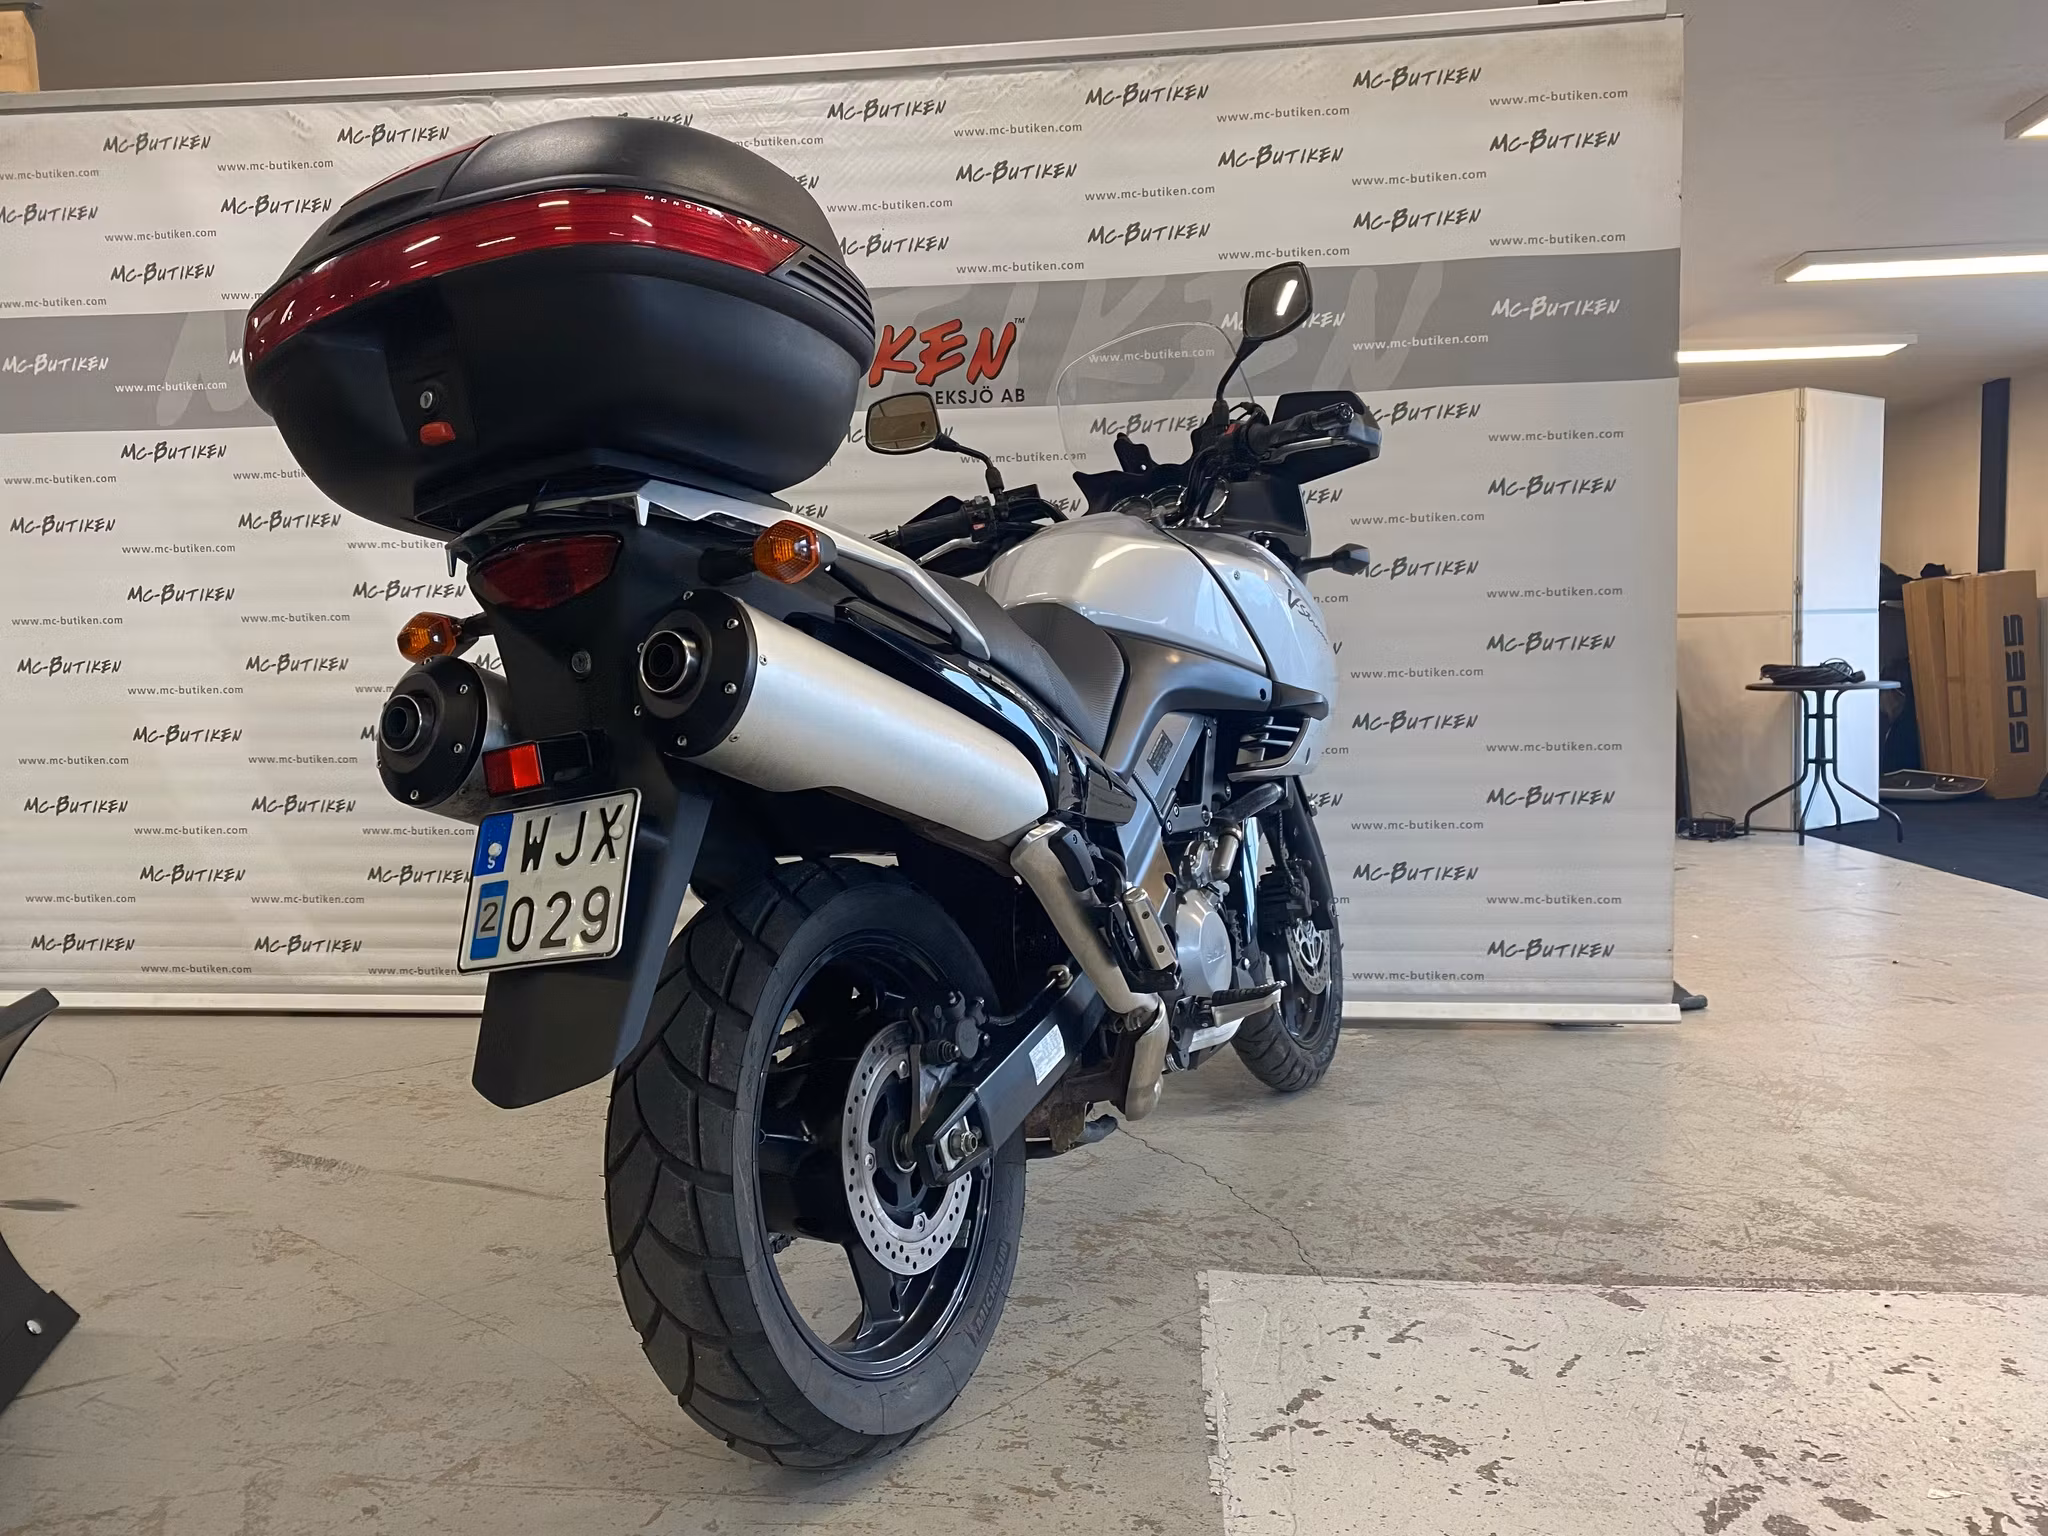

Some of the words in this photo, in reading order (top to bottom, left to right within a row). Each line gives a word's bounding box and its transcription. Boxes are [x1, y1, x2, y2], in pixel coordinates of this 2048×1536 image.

[1490, 89, 1628, 106] www.mc-butiken.com
[1217, 106, 1349, 123] www.mc-butiken.com
[953, 122, 1082, 138] www.mc-butiken.com
[218, 160, 333, 172] www.mc-butiken.com
[1352, 170, 1486, 186] www.mc-butiken.com
[1085, 185, 1214, 201] www.mc-butiken.com
[827, 197, 953, 214] www.mc-butiken.com
[105, 229, 216, 243] www.mc-butiken.com
[1490, 231, 1625, 248] www.mc-butiken.com
[1218, 245, 1350, 262] www.mc-butiken.com
[957, 260, 1084, 274] www.mc-butiken.com
[1353, 334, 1488, 351] www.mc-butiken.com
[1089, 346, 1215, 364] www.mc-butiken.com
[115, 378, 226, 393] www.mc-butiken.com
[935, 386, 993, 405] EKSJÖ
[1001, 389, 1025, 403] AB
[1489, 429, 1623, 442] www.mc-butiken.com
[4, 474, 116, 485] www.mc-butiken.com
[1350, 511, 1484, 526] www.mc-butiken.com
[122, 543, 235, 554] www.mc-butiken.com
[1487, 586, 1622, 599] www.mc-butiken.com
[12, 615, 122, 626] www.mc-butiken.com
[241, 612, 350, 623] www.mc-butiken.com
[1351, 666, 1483, 679] www.mc-butiken.com
[128, 684, 243, 695] www.mc-butiken.com
[2003, 614, 2030, 753] GOES
[1486, 741, 1622, 752] www.mc-butiken.com
[18, 755, 128, 765] www.mc-butiken.com
[248, 754, 358, 764] www.mc-butiken.com
[133, 825, 247, 835] www.mc-butiken.com
[363, 825, 474, 837] www.mc-butiken.com
[1351, 819, 1483, 830] www.mc-butiken.com
[520, 803, 627, 873] WJX
[26, 893, 135, 904] www.mc-butiken.com
[251, 893, 364, 905] www.mc-butiken.com
[1487, 894, 1621, 905] www.mc-butiken.com
[480, 902, 498, 932] 2
[506, 885, 611, 952] 029
[141, 963, 251, 974] www.mc-butiken.com
[1353, 970, 1485, 981] www.mc-butiken.com
